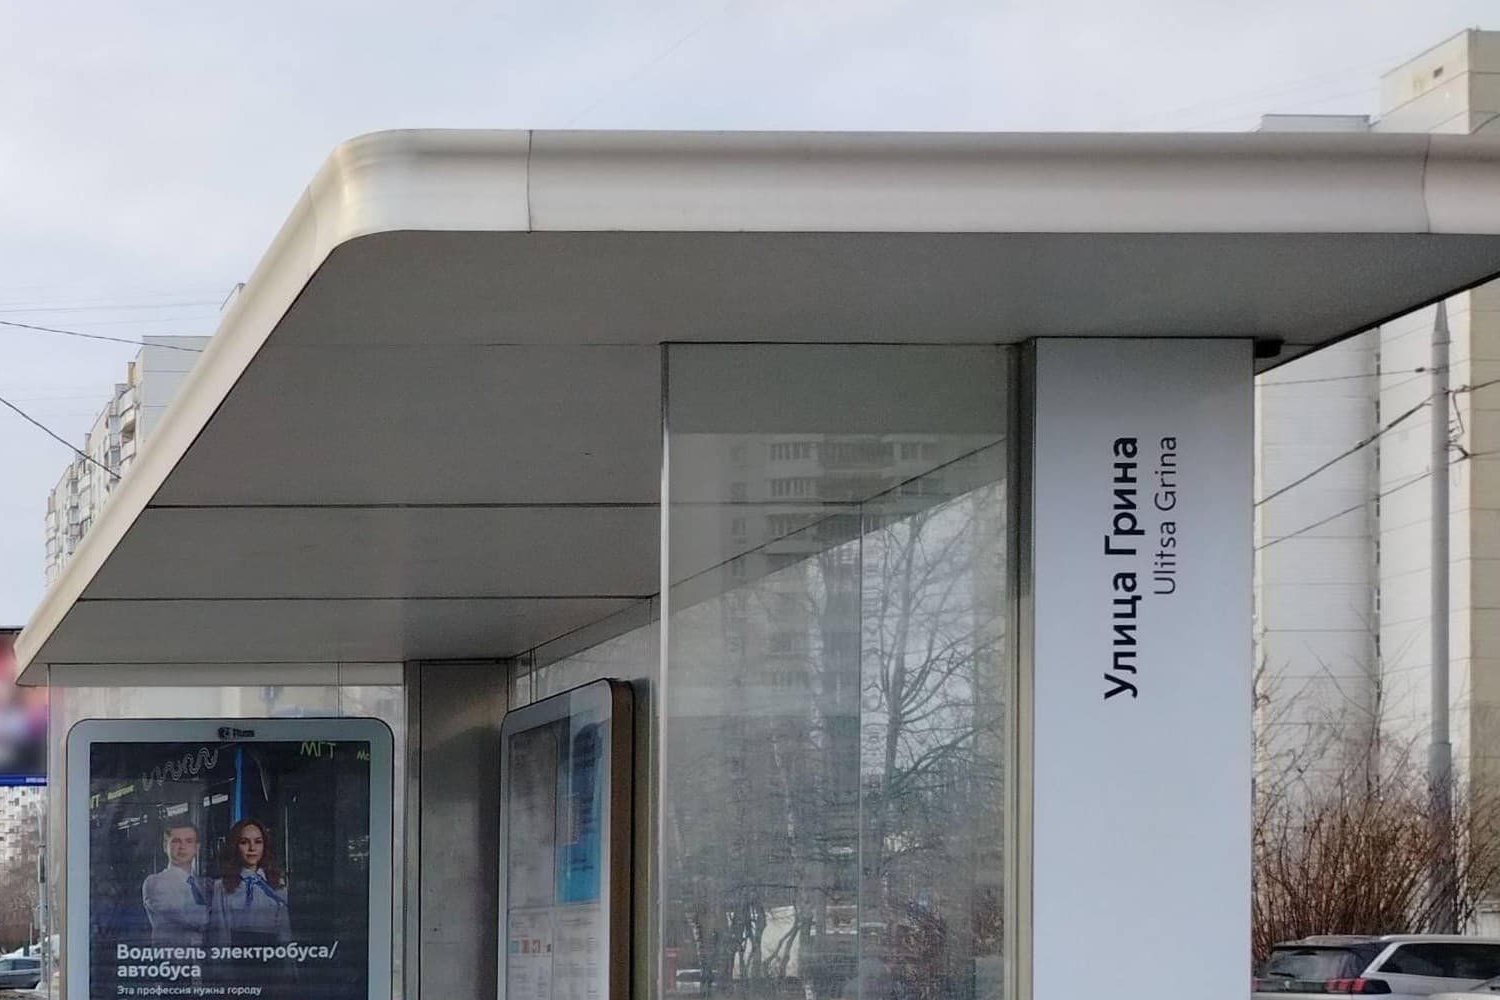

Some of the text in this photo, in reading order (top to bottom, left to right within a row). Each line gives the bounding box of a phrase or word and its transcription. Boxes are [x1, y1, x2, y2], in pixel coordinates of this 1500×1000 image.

[1152, 436, 1177, 595] Ulitsa Grina
[1103, 436, 1145, 700] Улица Грина
[300, 741, 337, 760] МГТ
[116, 941, 339, 962] Водитель электробуса/
[116, 962, 202, 981] автобуса
[116, 985, 263, 997] Эта профессия нужна городу
